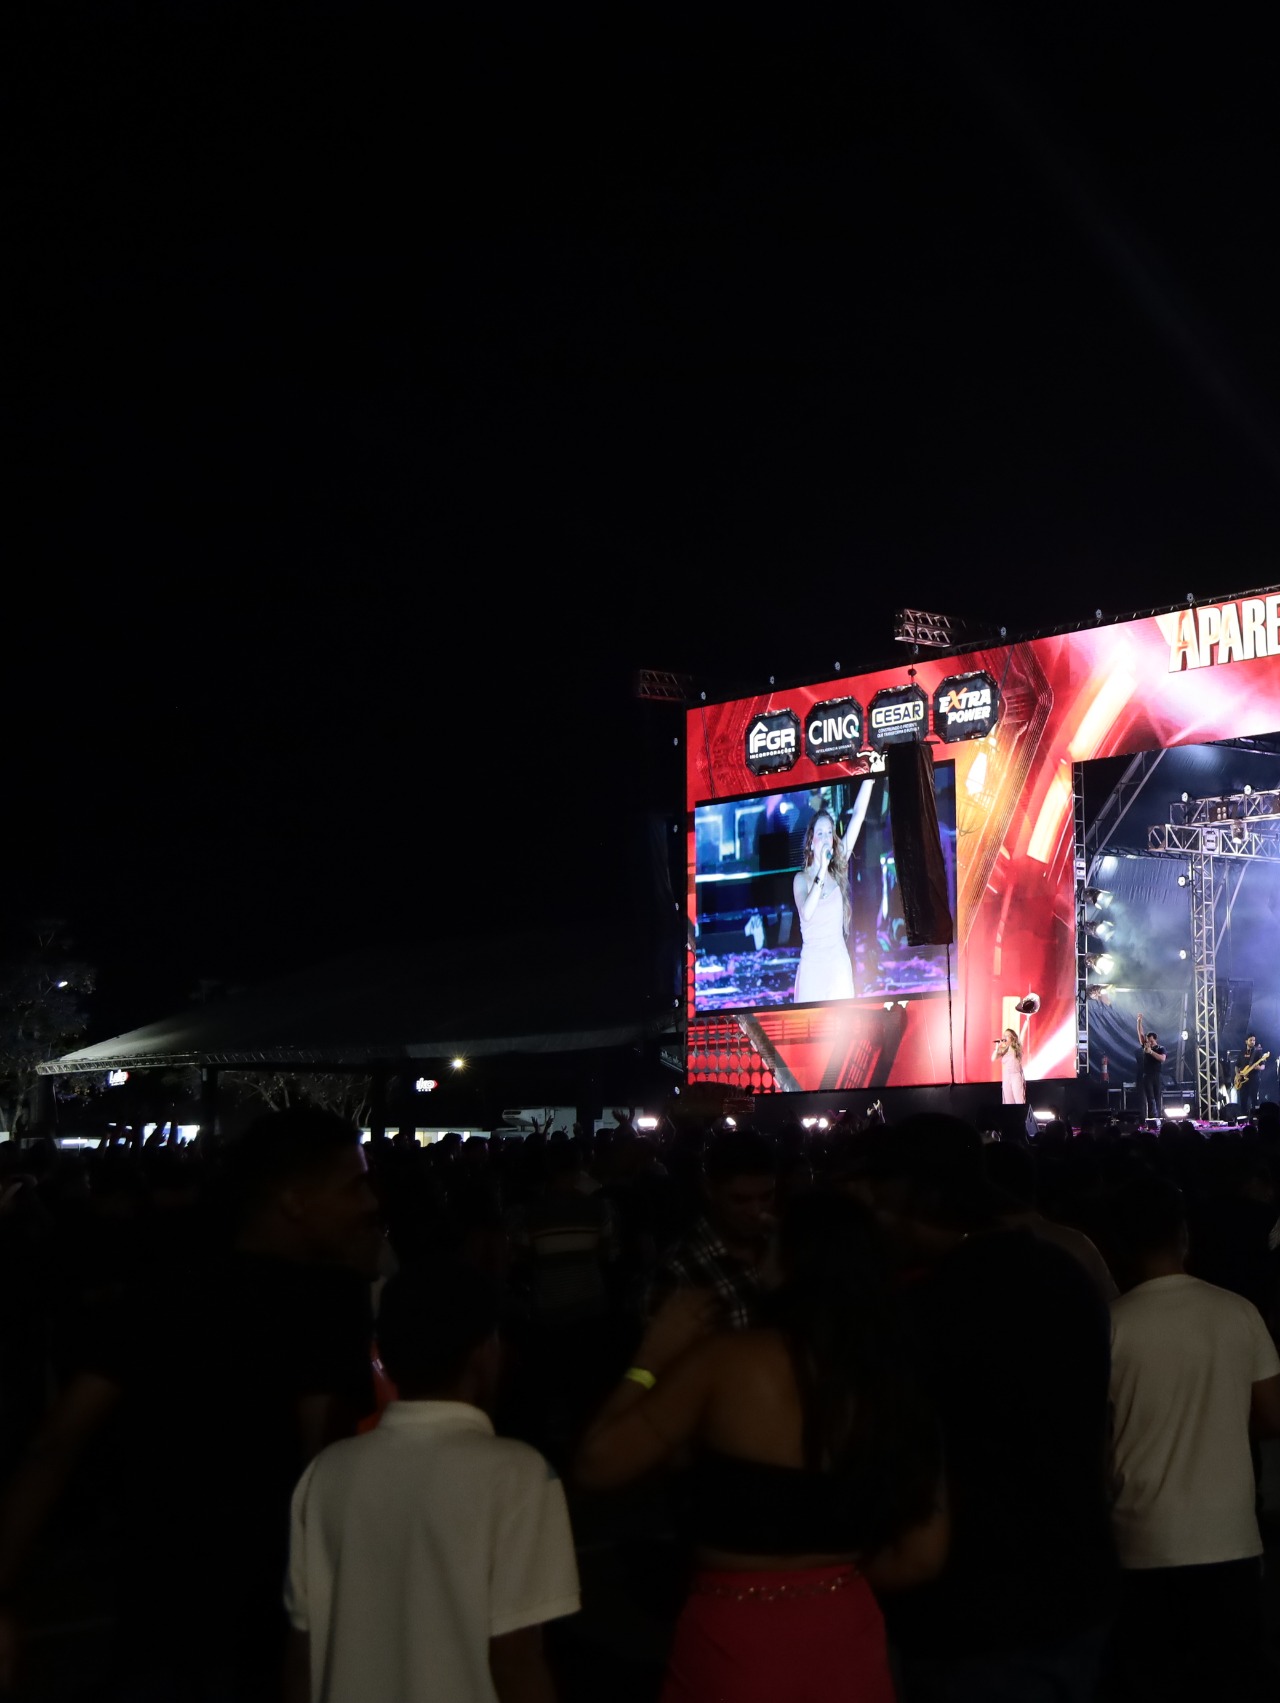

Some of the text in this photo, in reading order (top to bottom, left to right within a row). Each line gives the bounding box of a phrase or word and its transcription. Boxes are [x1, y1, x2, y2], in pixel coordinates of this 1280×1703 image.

[939, 687, 992, 714] EXTRA
[875, 704, 921, 725] CESAR
[947, 705, 992, 725] POWER
[753, 728, 796, 753] FGR
[808, 714, 860, 745] CINQ
